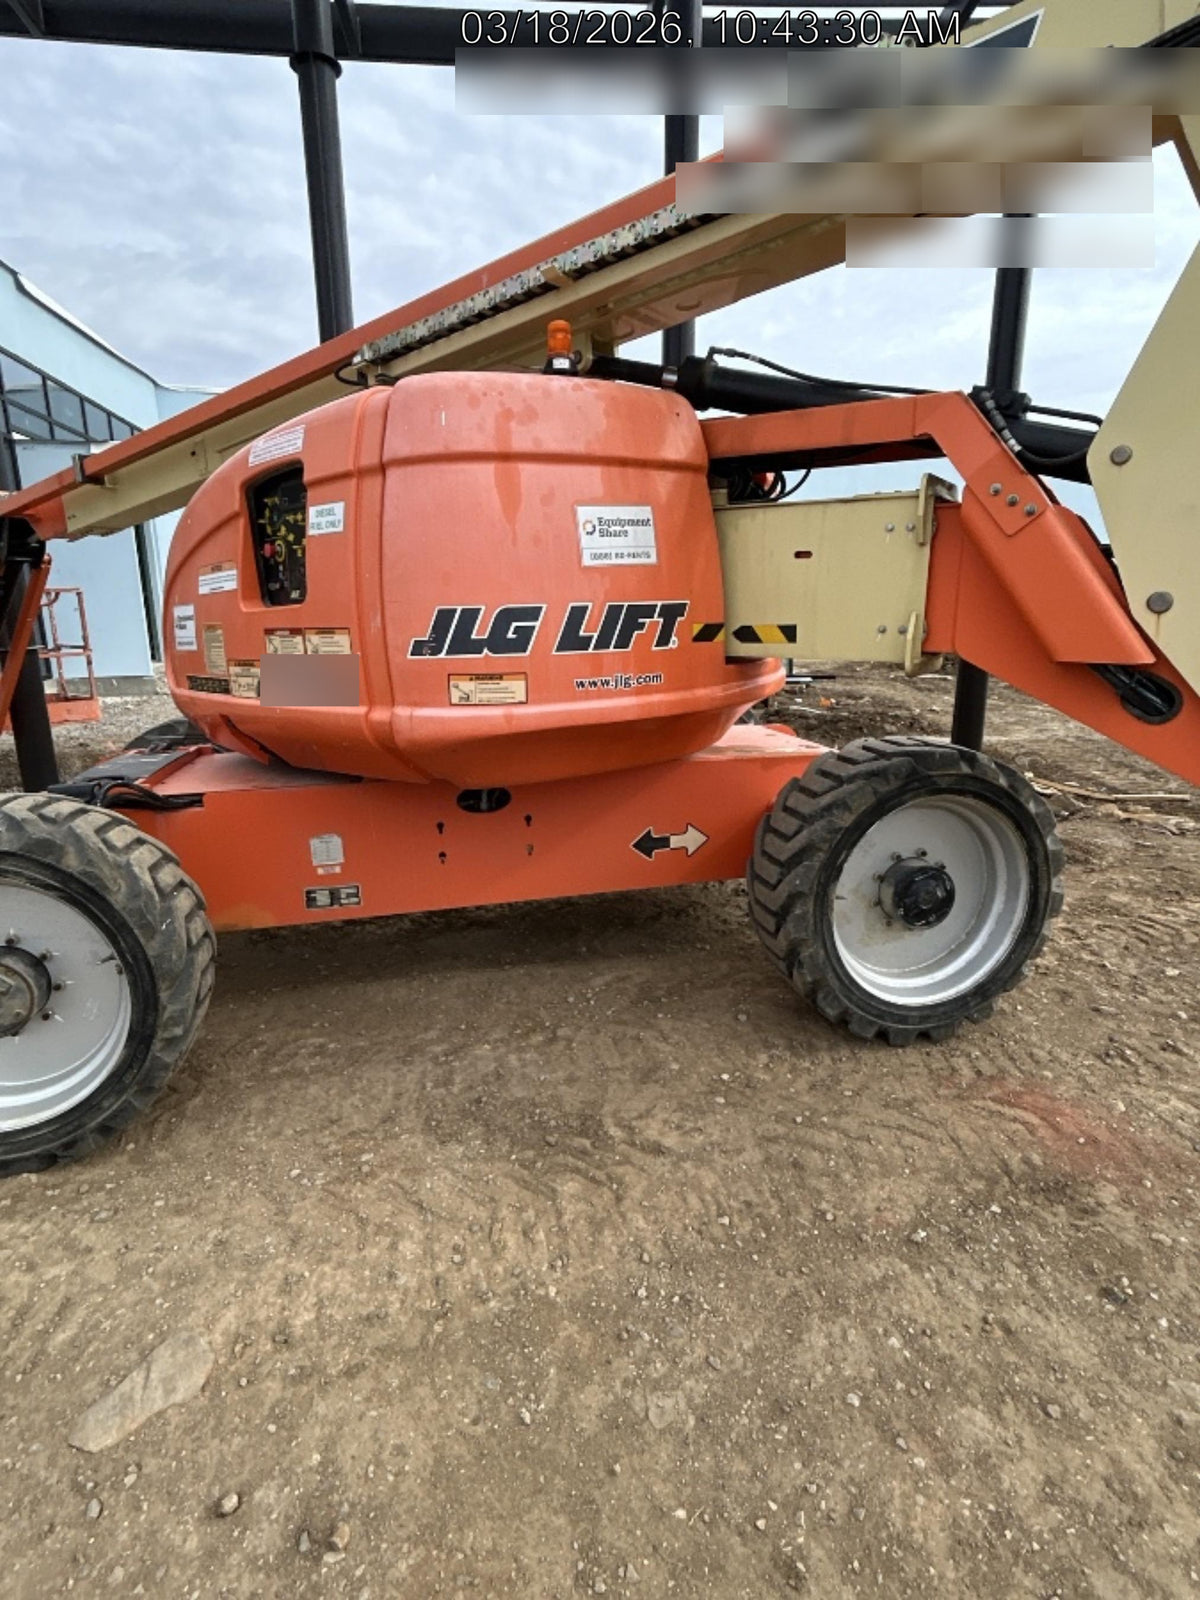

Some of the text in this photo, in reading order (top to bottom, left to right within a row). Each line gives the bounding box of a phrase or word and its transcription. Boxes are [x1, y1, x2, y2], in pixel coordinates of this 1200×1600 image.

[597, 516, 652, 529] Equipment
[598, 527, 629, 538] Share
[407, 604, 547, 659] JLG
[573, 672, 664, 691] www.jlg.com
